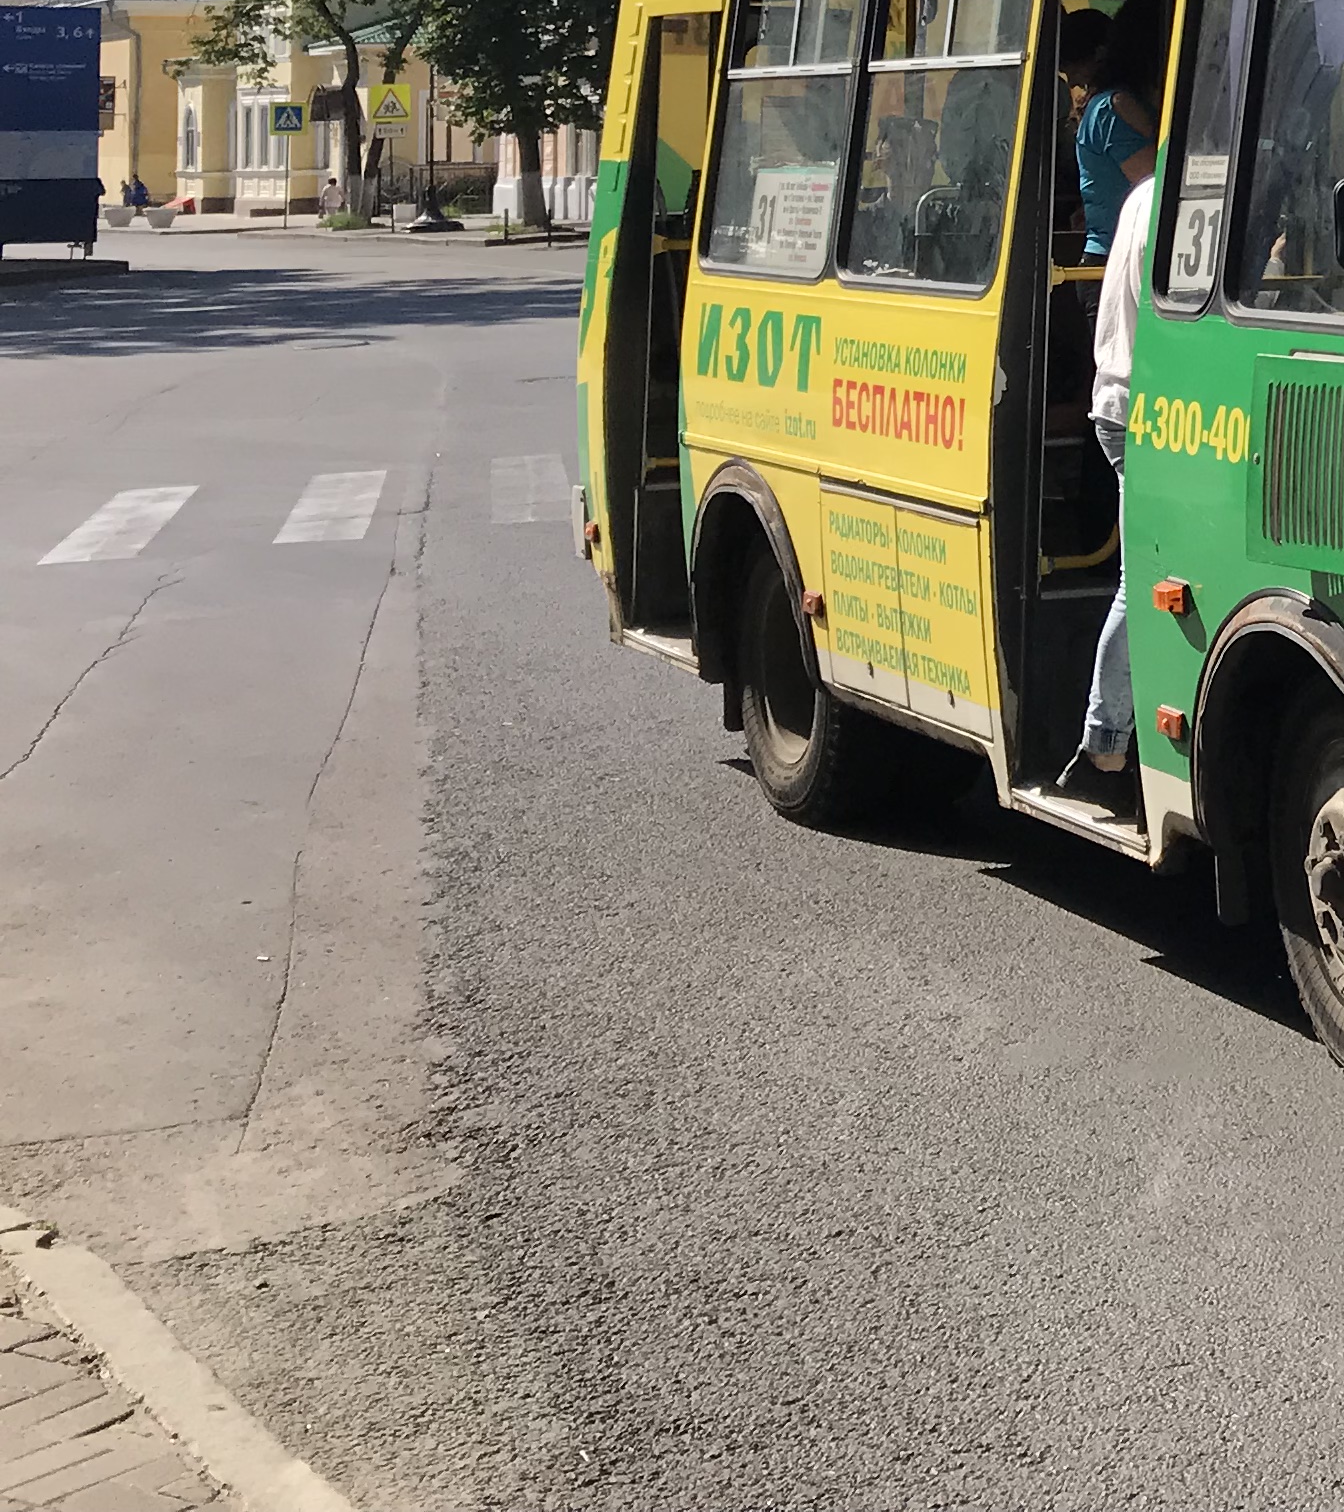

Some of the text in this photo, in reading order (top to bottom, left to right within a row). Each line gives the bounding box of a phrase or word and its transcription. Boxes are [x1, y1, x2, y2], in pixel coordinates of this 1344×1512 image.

[697, 302, 822, 393] ИЗОТ
[833, 336, 967, 384] УСТАНОВКА КОЛОНКИ
[741, 410, 753, 428] на
[784, 408, 816, 440] izot.ru
[832, 378, 966, 451] БЕСПЛАТНО!
[829, 509, 947, 565] РАДИАТОРЫ КОЛОНКИ
[830, 549, 978, 618] ВОДОНАГРЕВАТЕЛИ КОТЛЫ
[832, 589, 932, 644] ПЛИТЫ ВЫТЯЖКИ
[836, 627, 972, 697] ВСТРАИВАЕМАЯ ТЕХНИКА
